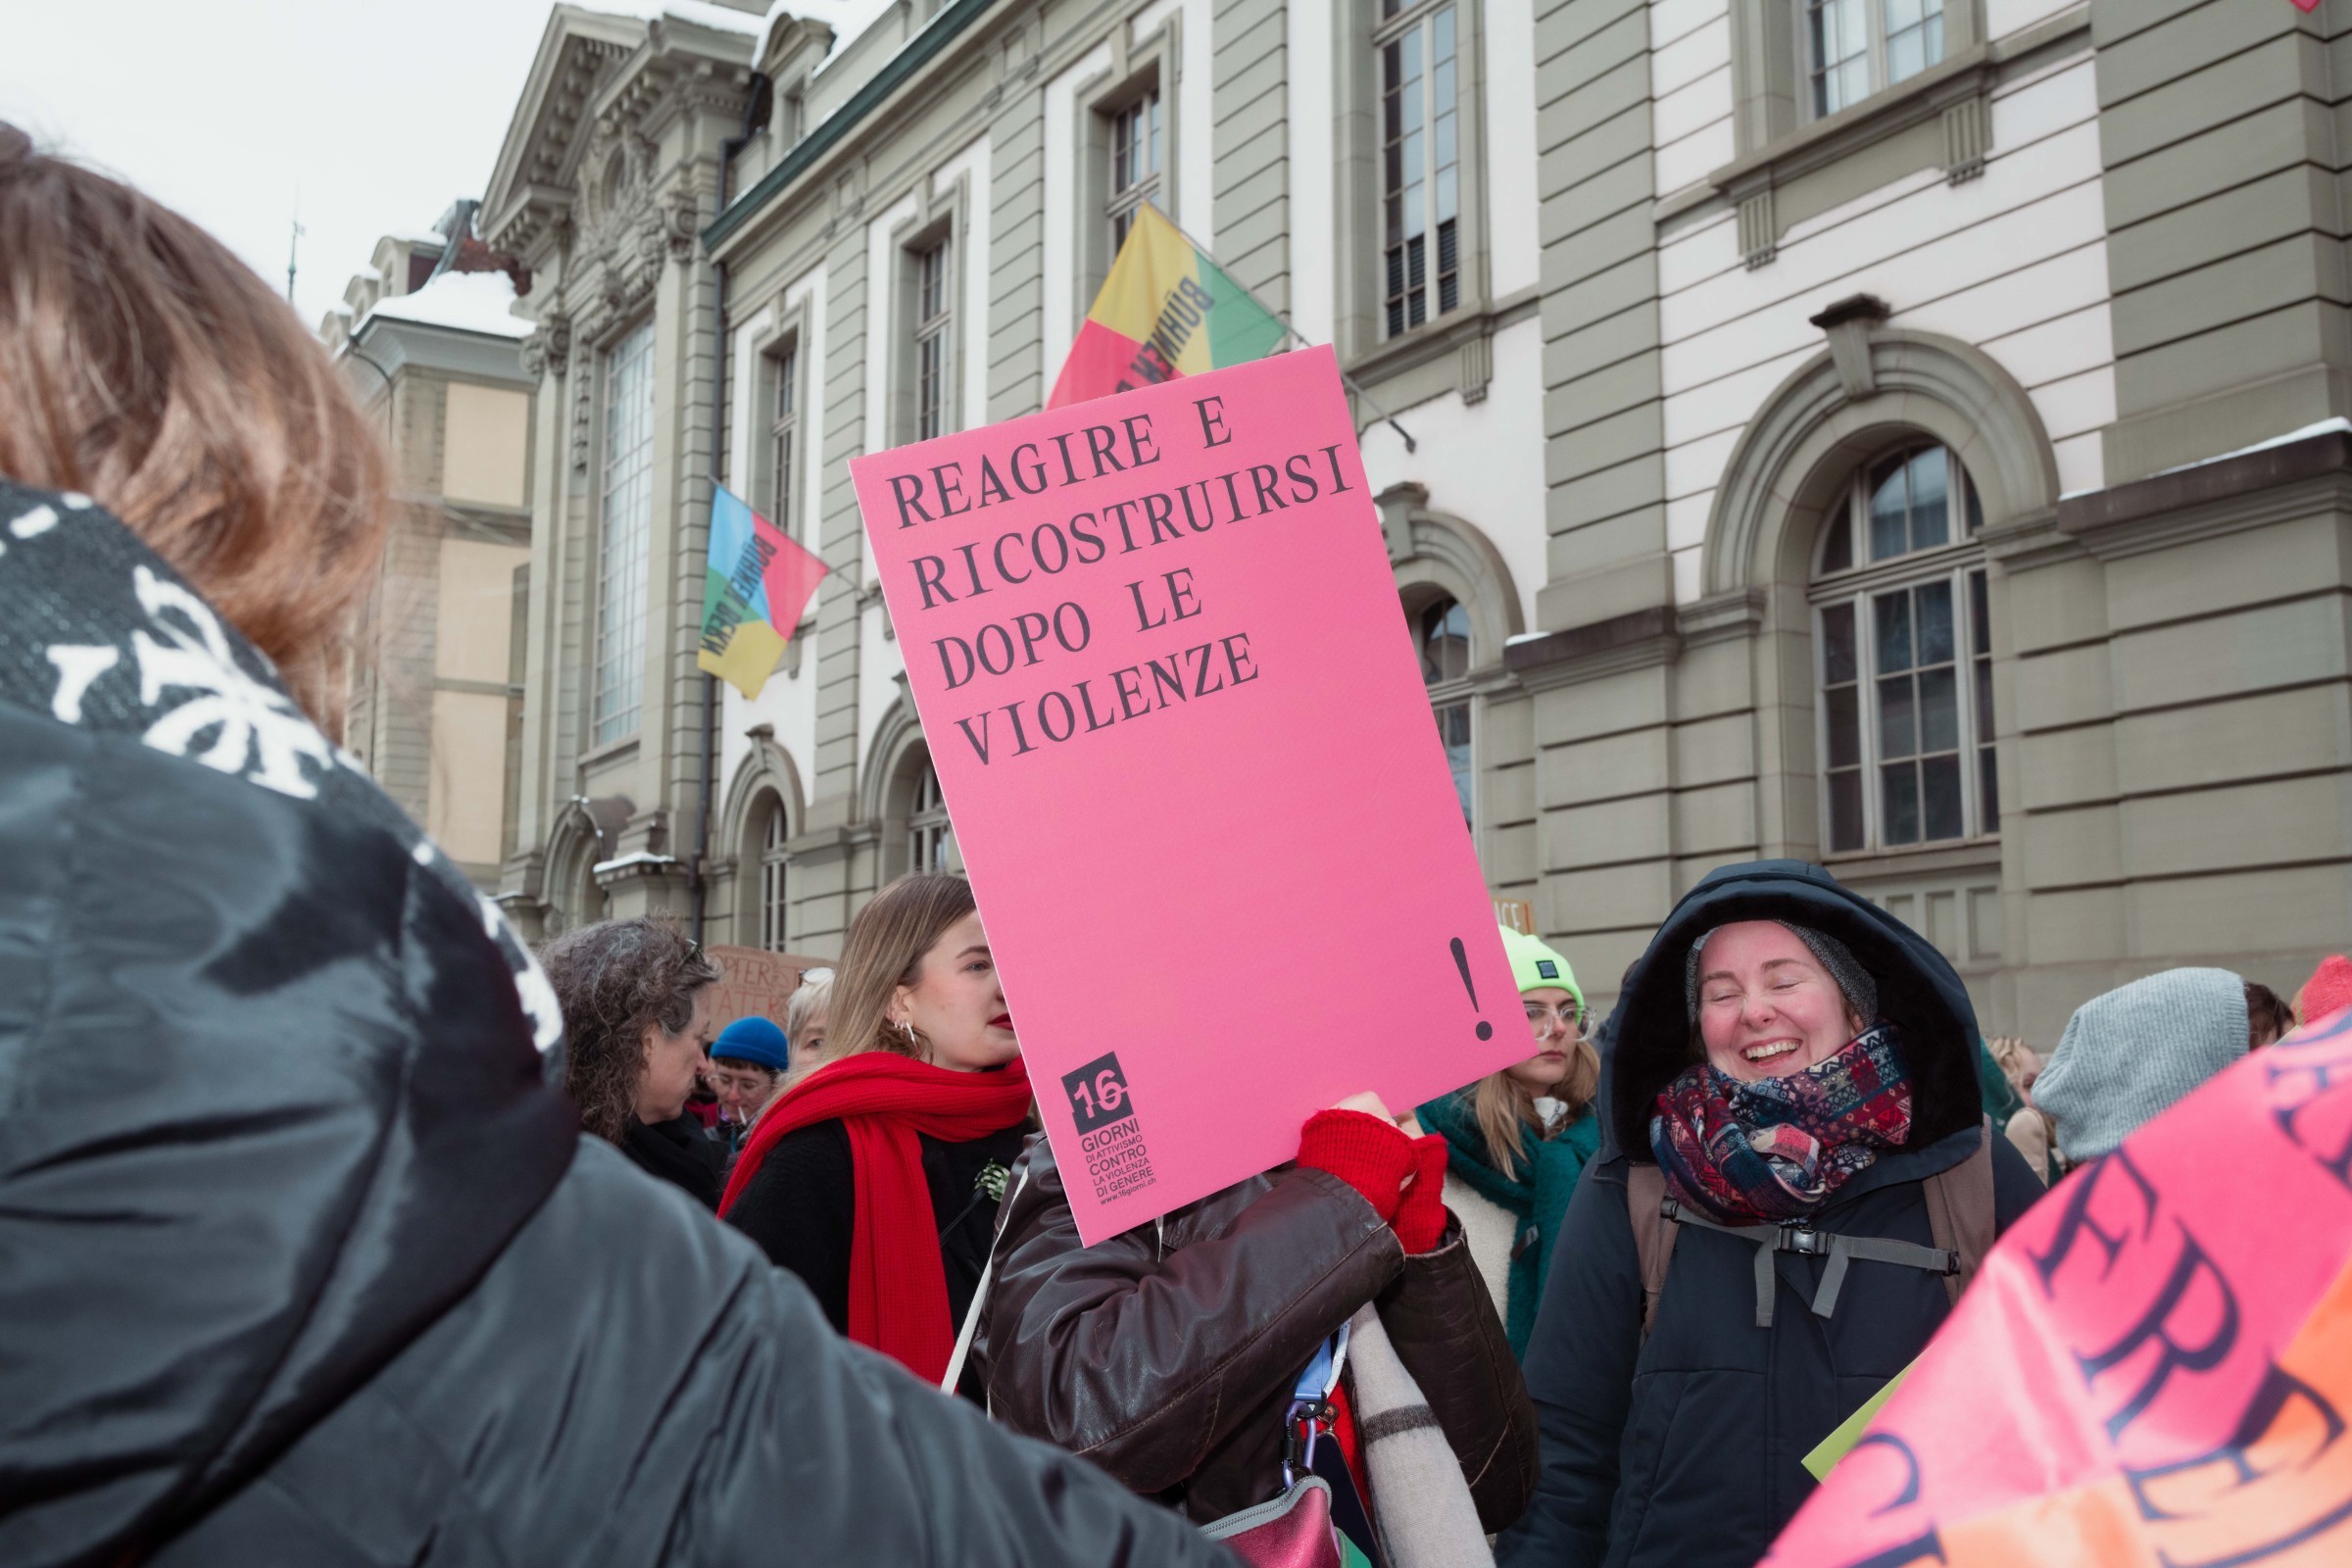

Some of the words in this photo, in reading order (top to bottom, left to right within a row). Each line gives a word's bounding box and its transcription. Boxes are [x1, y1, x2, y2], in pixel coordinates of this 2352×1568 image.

[886, 414, 1161, 529] REAGIRE
[1192, 396, 1233, 449] E
[907, 444, 1353, 611] RICOSTRUIRSI
[930, 601, 1092, 691] DOPO
[1124, 567, 1202, 632] LE
[954, 632, 1259, 766] VIOLENZE
[1449, 937, 1493, 1041] !
[1073, 1069, 1123, 1119] 16
[1081, 1118, 1140, 1152] GIORNI
[1085, 1154, 1096, 1163] DI
[1097, 1134, 1143, 1159] ATTIVISMO
[1089, 1145, 1147, 1176] CONTRO
[1093, 1176, 1105, 1187] LA
[1106, 1157, 1151, 1181] VIOLENZA
[1096, 1187, 1108, 1198] DI
[1109, 1166, 1154, 1193] GENERE
[1100, 1177, 1156, 1205] www.16giorni.ch
